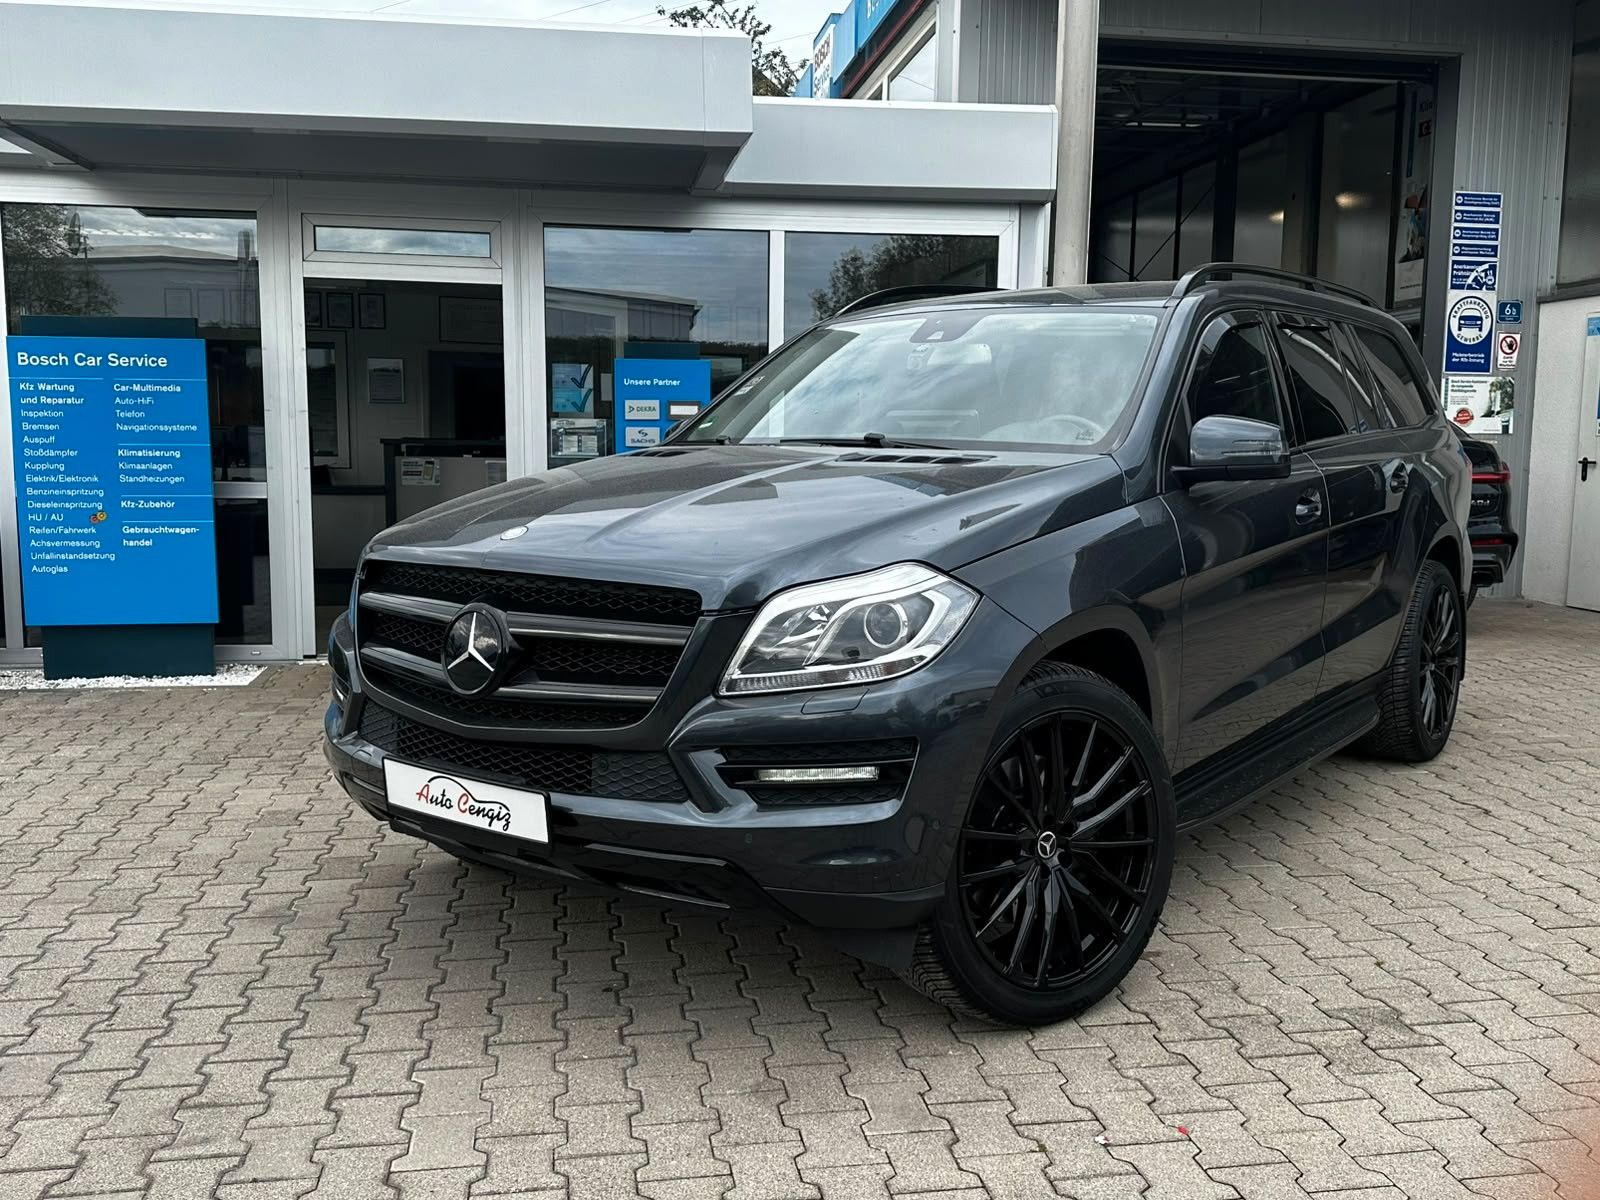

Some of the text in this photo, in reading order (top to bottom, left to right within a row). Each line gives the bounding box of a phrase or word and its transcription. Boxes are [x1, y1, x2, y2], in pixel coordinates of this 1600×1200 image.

[18, 352, 167, 367] Bosch Car Service
[623, 378, 681, 386] Unsere Partner
[38, 383, 74, 392] Wartung
[41, 396, 83, 405] Reparatur
[117, 424, 197, 432] Navigationssysteme
[24, 436, 54, 444] Auspuff
[118, 449, 180, 458] Klimatisierung
[25, 462, 64, 471] Kupplung
[119, 463, 172, 471] Klimaanlagen
[120, 475, 184, 484] Standheizungen
[27, 488, 104, 496] Benzineinspritzung
[28, 501, 102, 510] Dieseleinspritzung
[123, 526, 199, 534] Gebrauchtwagen-
[31, 540, 100, 548] Achsvermessung
[32, 566, 68, 574] Autoglas
[416, 783, 511, 831] Auto Cengiz
